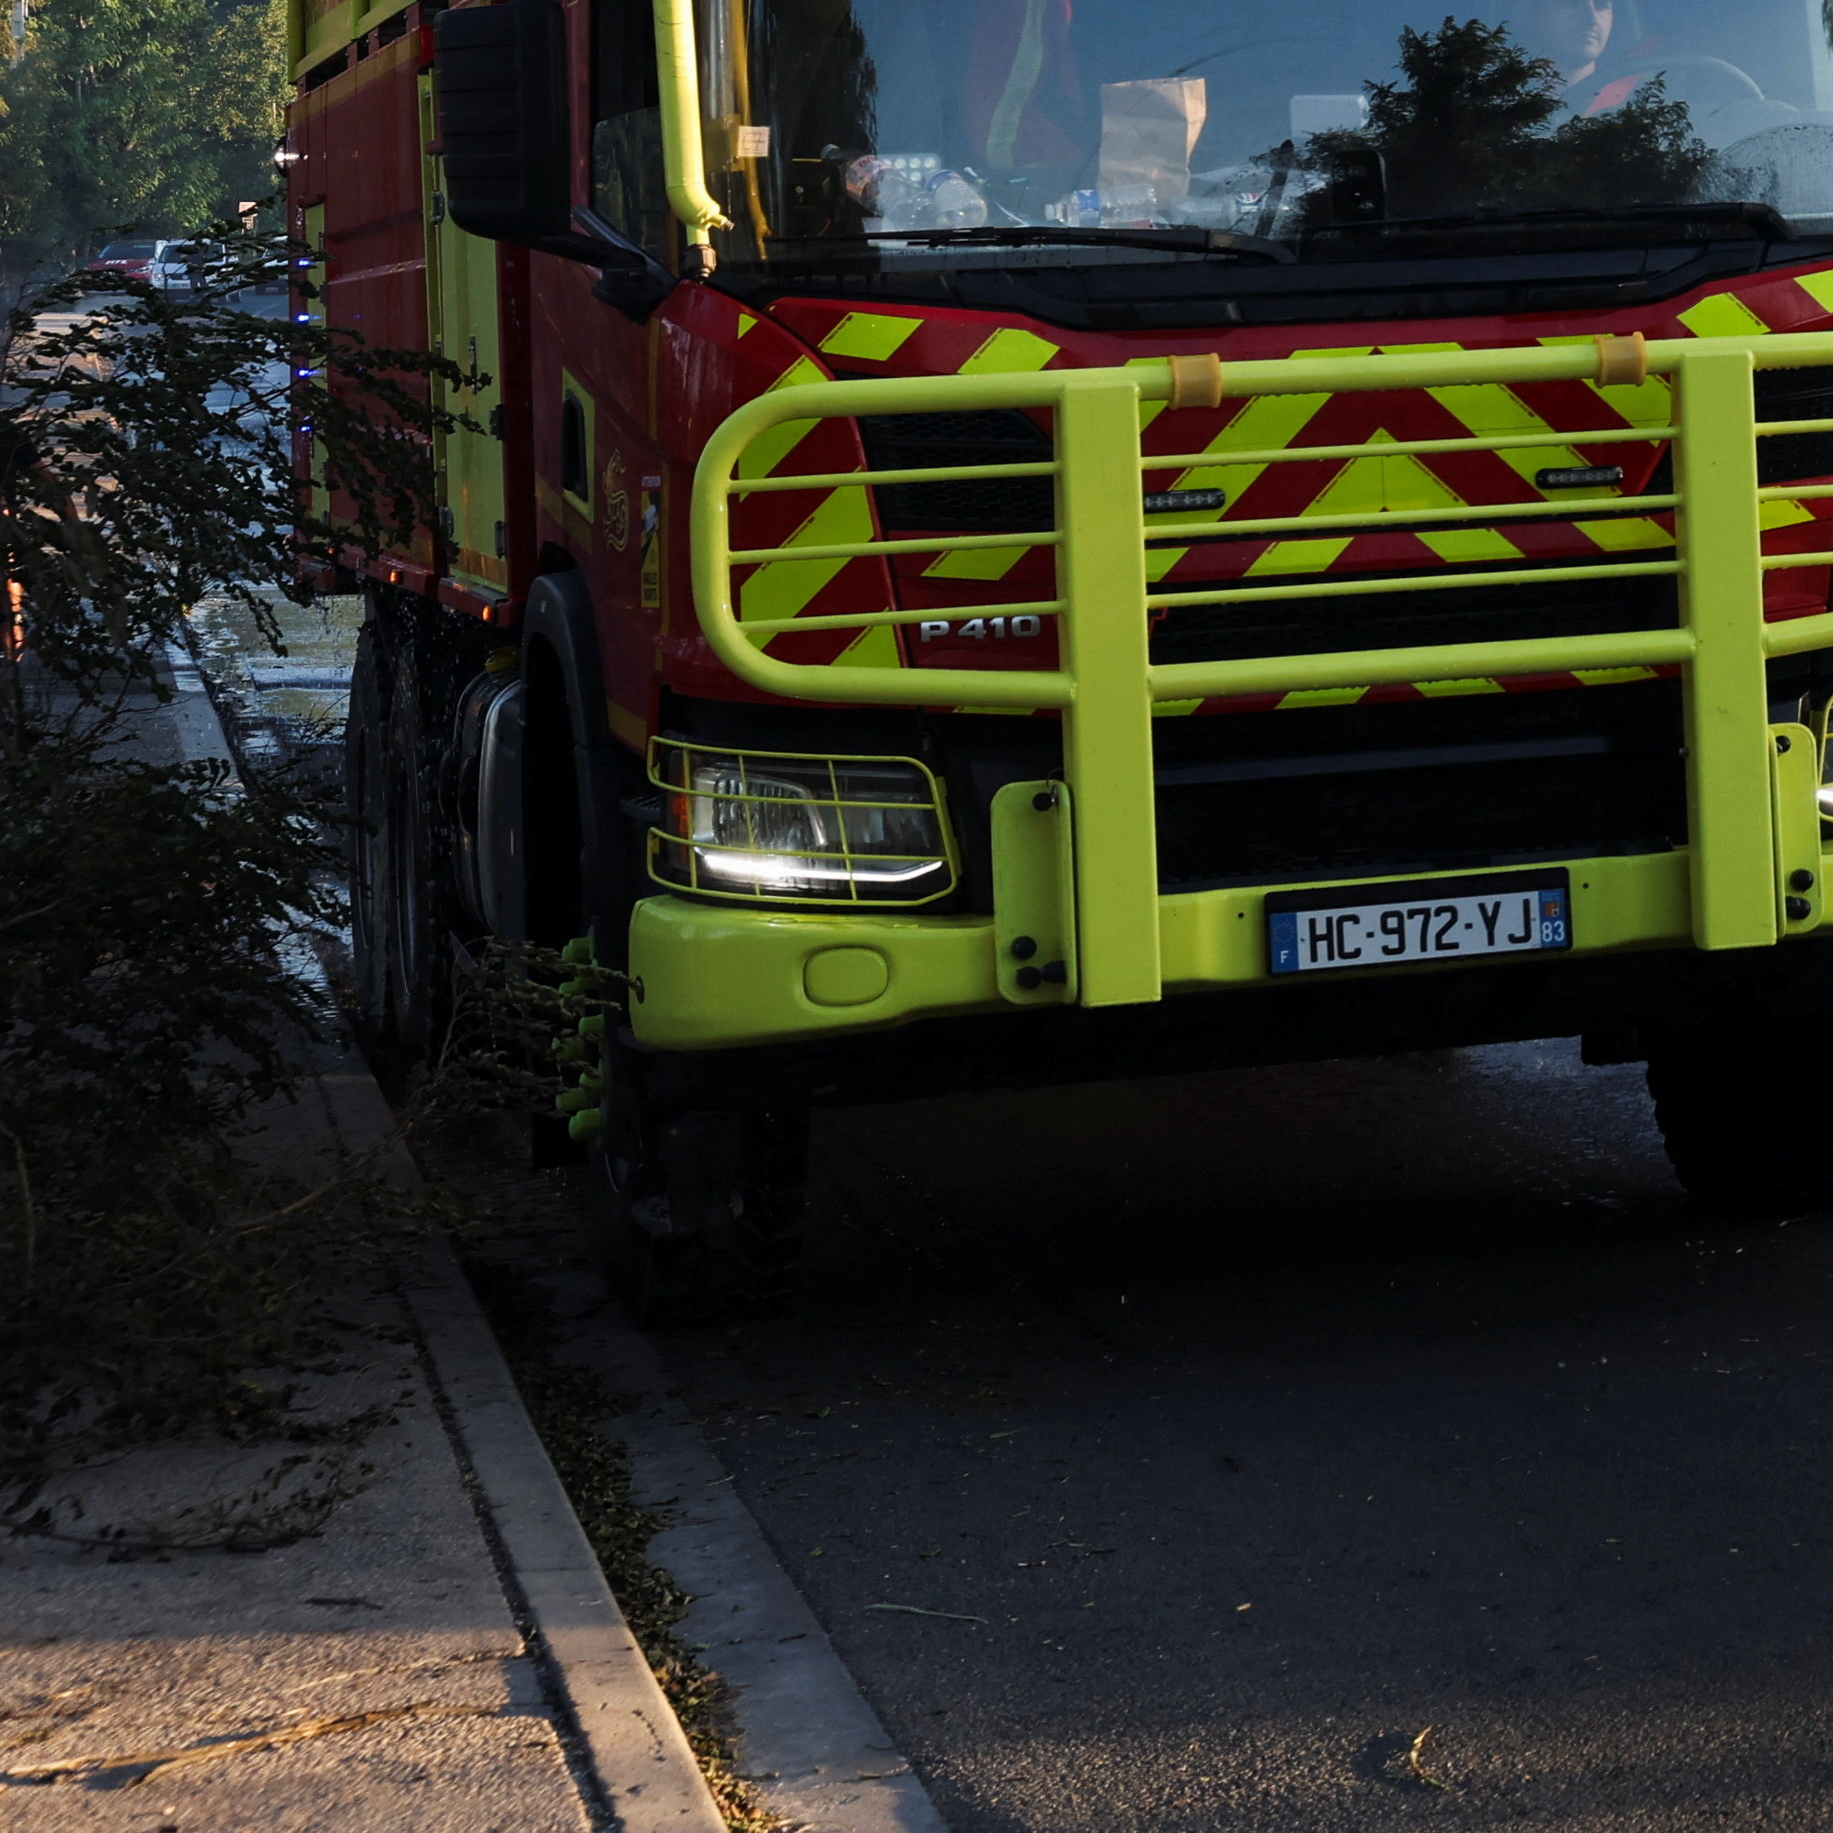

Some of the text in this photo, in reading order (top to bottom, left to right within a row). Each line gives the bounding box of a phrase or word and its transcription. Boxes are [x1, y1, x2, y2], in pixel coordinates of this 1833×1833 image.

[920, 615, 1041, 643] P 410
[1308, 898, 1532, 963] HC-972-YJ
[1541, 920, 1565, 943] 83
[1279, 950, 1289, 964] F
